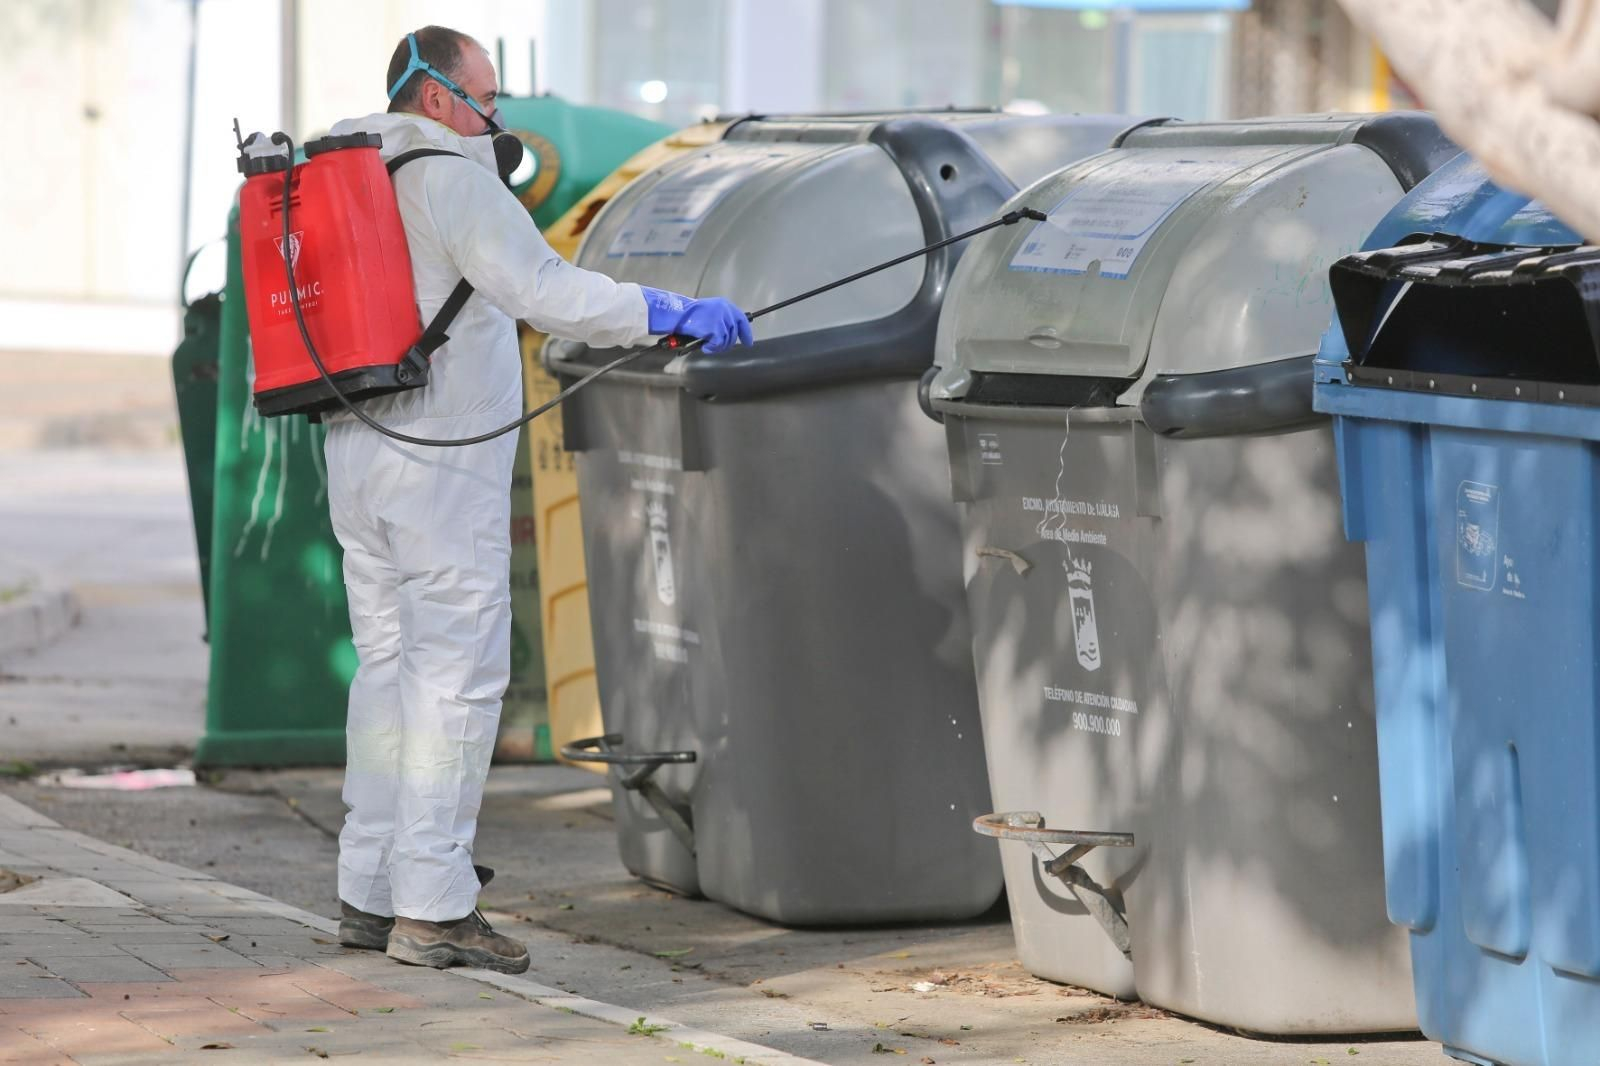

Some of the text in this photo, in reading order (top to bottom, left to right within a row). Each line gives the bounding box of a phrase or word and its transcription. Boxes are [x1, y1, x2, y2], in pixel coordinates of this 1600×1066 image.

[1062, 527, 1080, 542] Medio
[1080, 530, 1106, 545] Ambiente
[1044, 684, 1074, 702] TELÉFONO
[1074, 690, 1083, 704] DE
[1083, 690, 1110, 709] ATENCIÓN
[1072, 711, 1121, 737] 900.900.000
